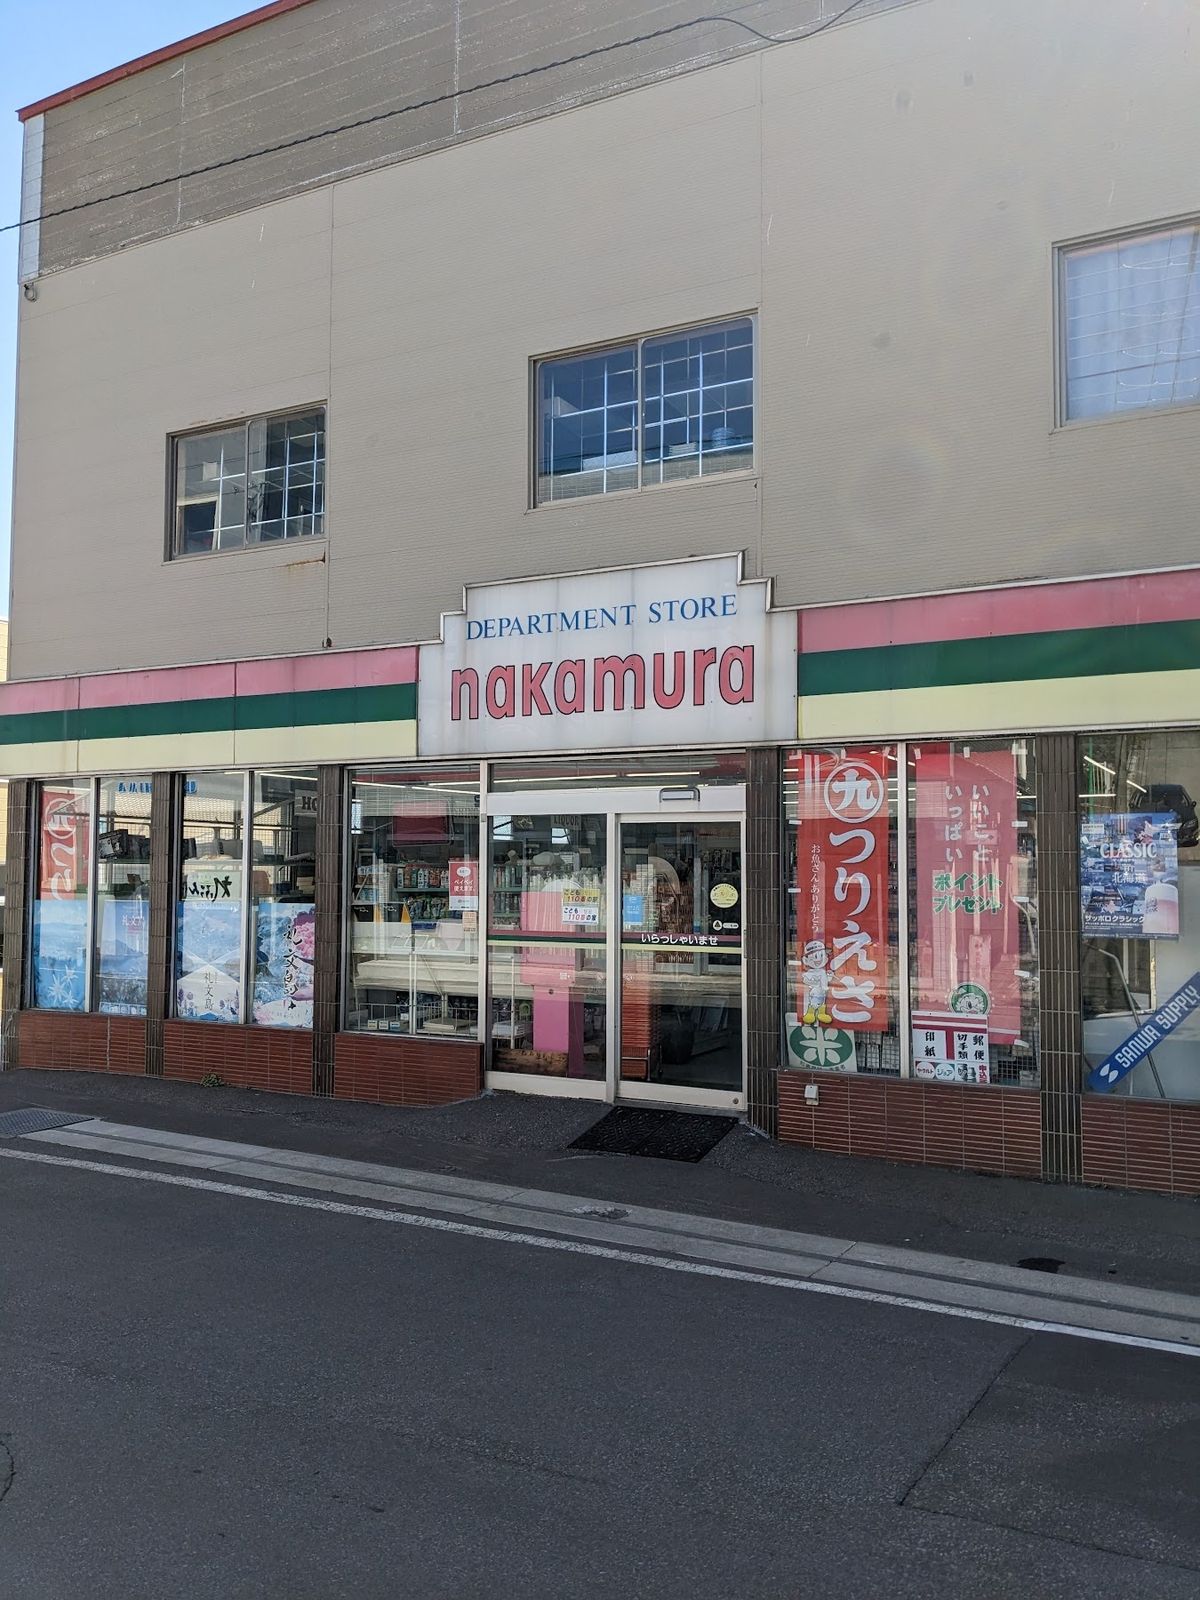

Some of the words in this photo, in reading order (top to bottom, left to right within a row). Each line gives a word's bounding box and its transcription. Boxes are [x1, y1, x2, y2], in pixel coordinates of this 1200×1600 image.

[466, 604, 637, 640] DEPARTMENT
[648, 594, 738, 624] STORE
[450, 644, 756, 722] nakamura
[944, 785, 963, 862] いっぱい
[1100, 841, 1157, 859] CLASSIC
[933, 872, 1004, 892] ポイント
[1111, 871, 1149, 885] 北海道
[932, 893, 1004, 915] プレゼント
[1085, 914, 1146, 923] サッポロクラシック
[641, 933, 719, 946] いらっしゃいませ
[1115, 1024, 1161, 1068] SANWA
[1155, 984, 1200, 1029] SUPPLY
[924, 1031, 936, 1057] 印紙
[957, 1033, 969, 1060] 切手類
[972, 1034, 985, 1061] 郵便
